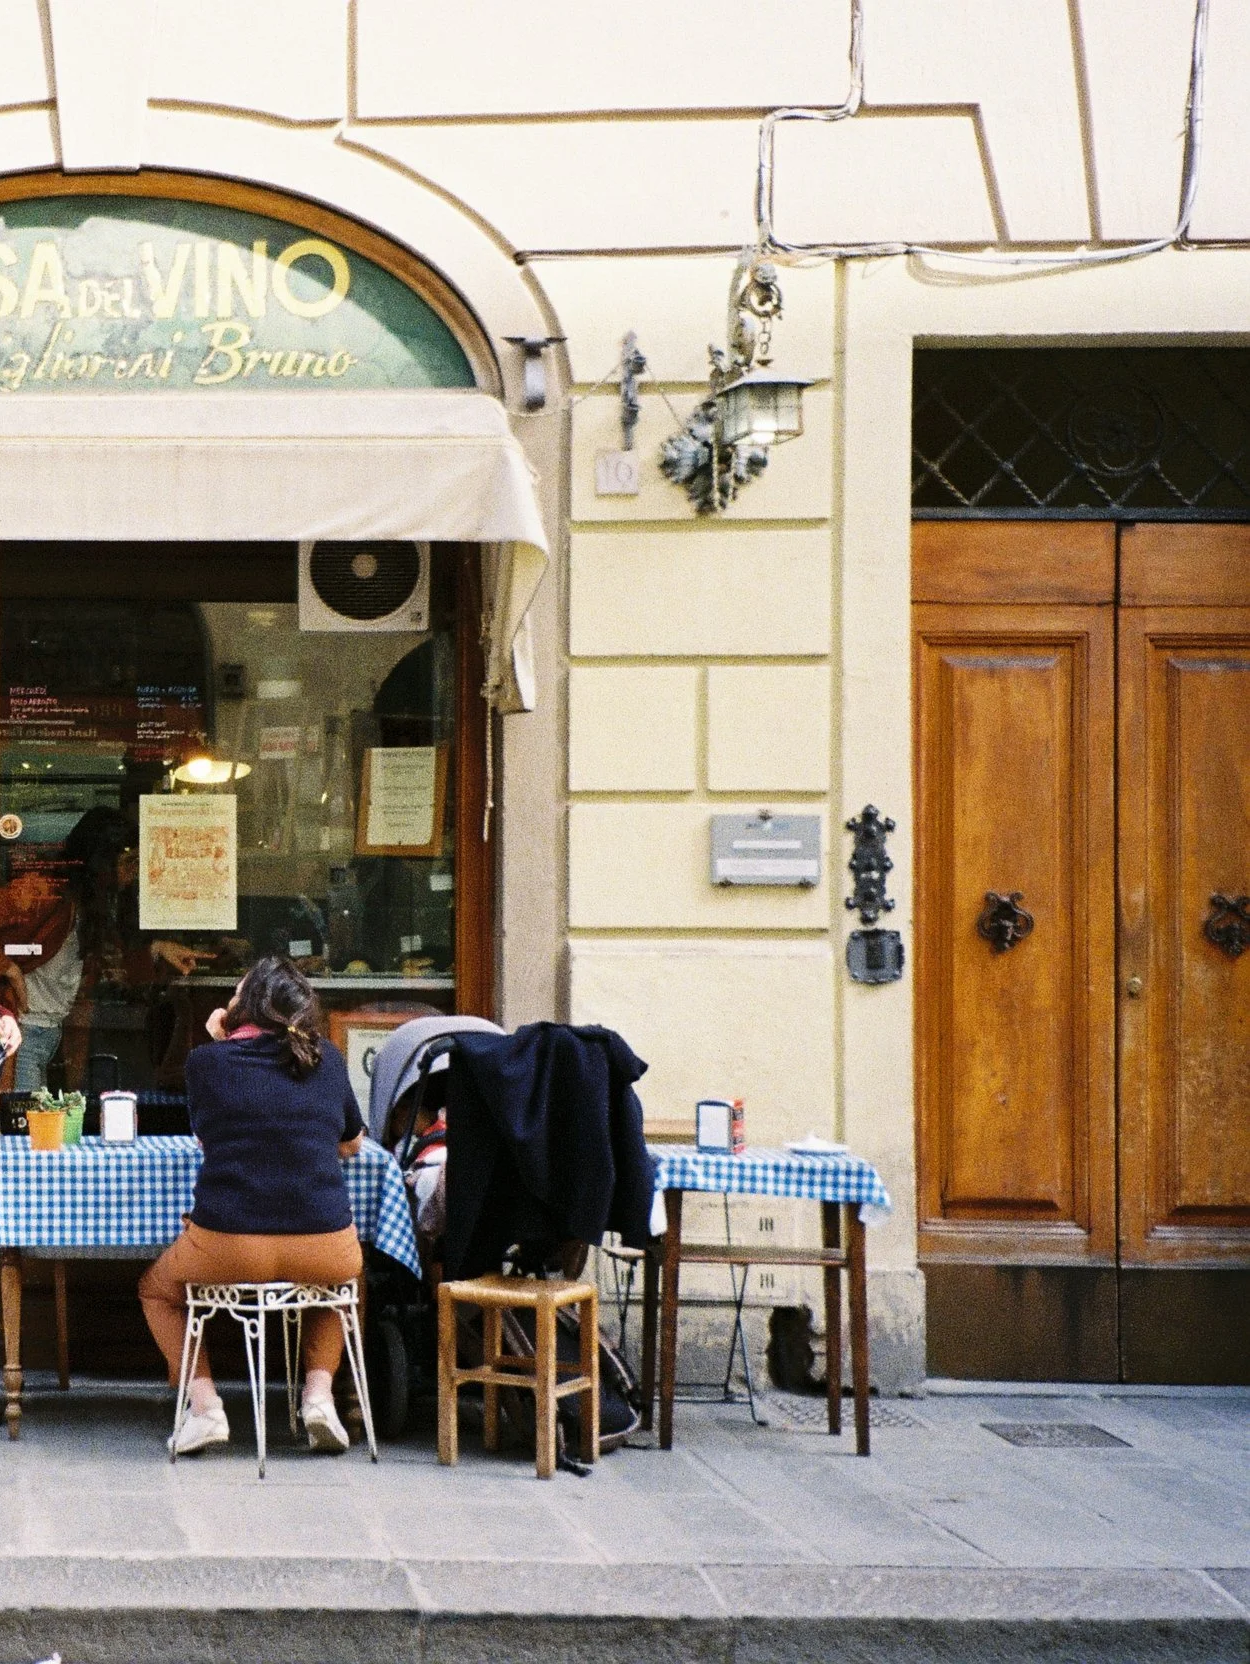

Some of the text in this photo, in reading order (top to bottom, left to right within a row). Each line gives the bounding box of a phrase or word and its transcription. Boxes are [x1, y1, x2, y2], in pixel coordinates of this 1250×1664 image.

[78, 279, 141, 319] DEL
[140, 238, 350, 318] VINO
[193, 321, 358, 385] Bruno
